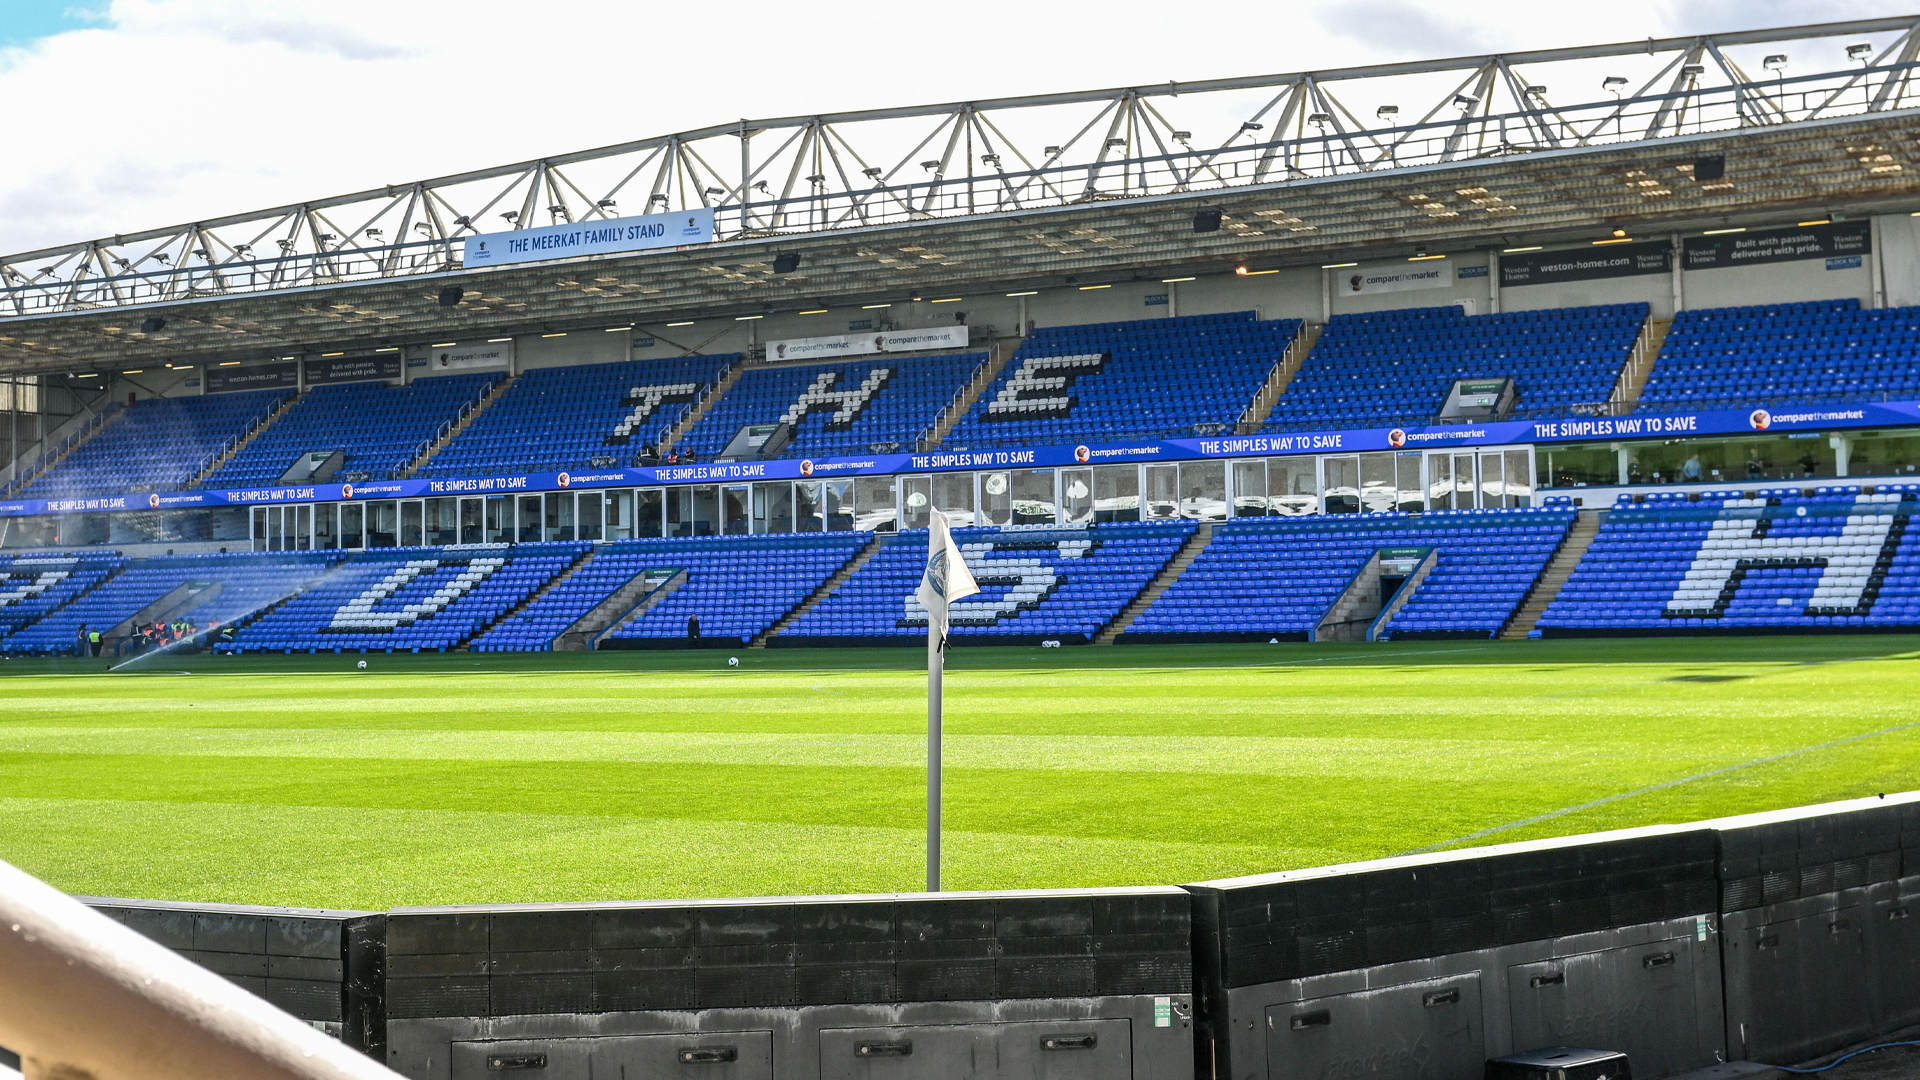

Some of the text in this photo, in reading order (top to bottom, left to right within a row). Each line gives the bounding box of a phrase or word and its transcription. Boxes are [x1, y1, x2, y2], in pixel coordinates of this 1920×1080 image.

[509, 223, 665, 253] THE MEERKAT FAMILY STAND
[1735, 239, 1756, 249] Built
[1758, 237, 1778, 246] with
[1833, 234, 1863, 242] Weston
[1834, 241, 1863, 250] Homes
[1688, 249, 1716, 257] Weston
[1731, 243, 1823, 260] delivered with pride.
[1636, 254, 1663, 262] Weston
[1689, 256, 1716, 264] Homes
[1504, 266, 1529, 274] Weston
[1540, 257, 1630, 273] weston-homes.com
[1637, 261, 1663, 269] Homes
[1366, 271, 1439, 284] comparethemarket
[1505, 273, 1529, 281] Homes
[888, 334, 951, 345] comparethemarket
[789, 342, 849, 353] comparethemarket
[451, 352, 499, 362] comparethemarket
[229, 373, 278, 383] weston-homes.com
[1772, 410, 1863, 424] comparethemarket
[1534, 416, 1697, 438] THE SIMPLES WAY TO SAVE
[1407, 429, 1485, 441] comparethemarket
[1200, 435, 1342, 454] THE SIMPLES WAY TO SAVE
[1091, 446, 1159, 458] comparethemarket
[912, 451, 1034, 468] THE SIMPLES WAY TO SAVE
[814, 461, 875, 471] comparethemarket
[655, 464, 765, 480] THE SIMPLES WAY TO SAVE
[430, 476, 527, 492] THE SIMPLES WAY TO SAVE
[571, 474, 624, 483] comparethemarket
[228, 488, 314, 502] THE SIMPLES WAY TO SAVE
[353, 486, 401, 495] comparethemarket
[47, 498, 125, 511] THE SIMPLES WAY TO SAVE
[160, 495, 202, 504] comparethemarket
